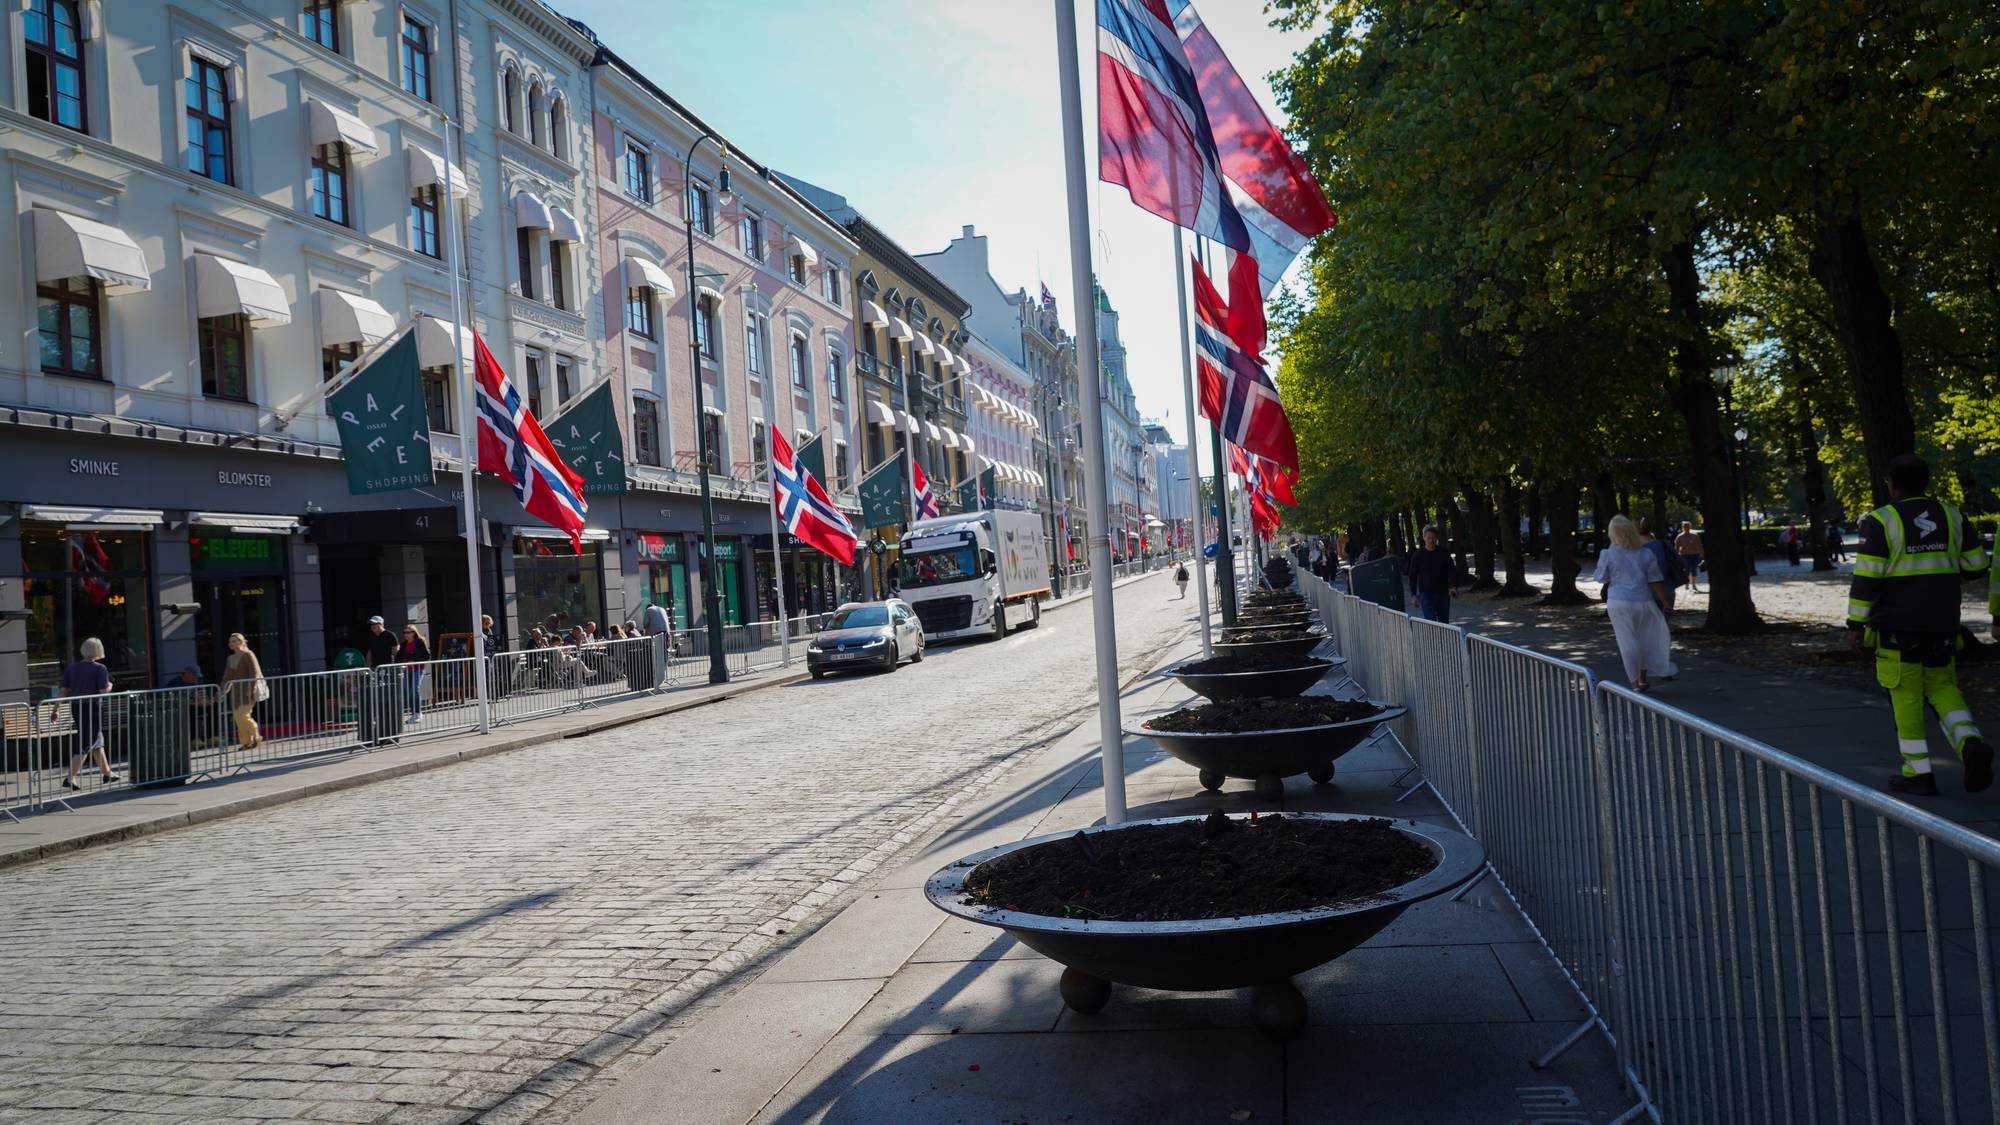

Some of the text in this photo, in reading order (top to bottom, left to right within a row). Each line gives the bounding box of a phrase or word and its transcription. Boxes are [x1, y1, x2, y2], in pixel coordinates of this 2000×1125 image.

[70, 459, 119, 476] SMINKE
[218, 471, 271, 487] BLOMSTER
[366, 473, 429, 489] SHOPPING
[415, 516, 429, 528] 41
[647, 543, 676, 557] unisport
